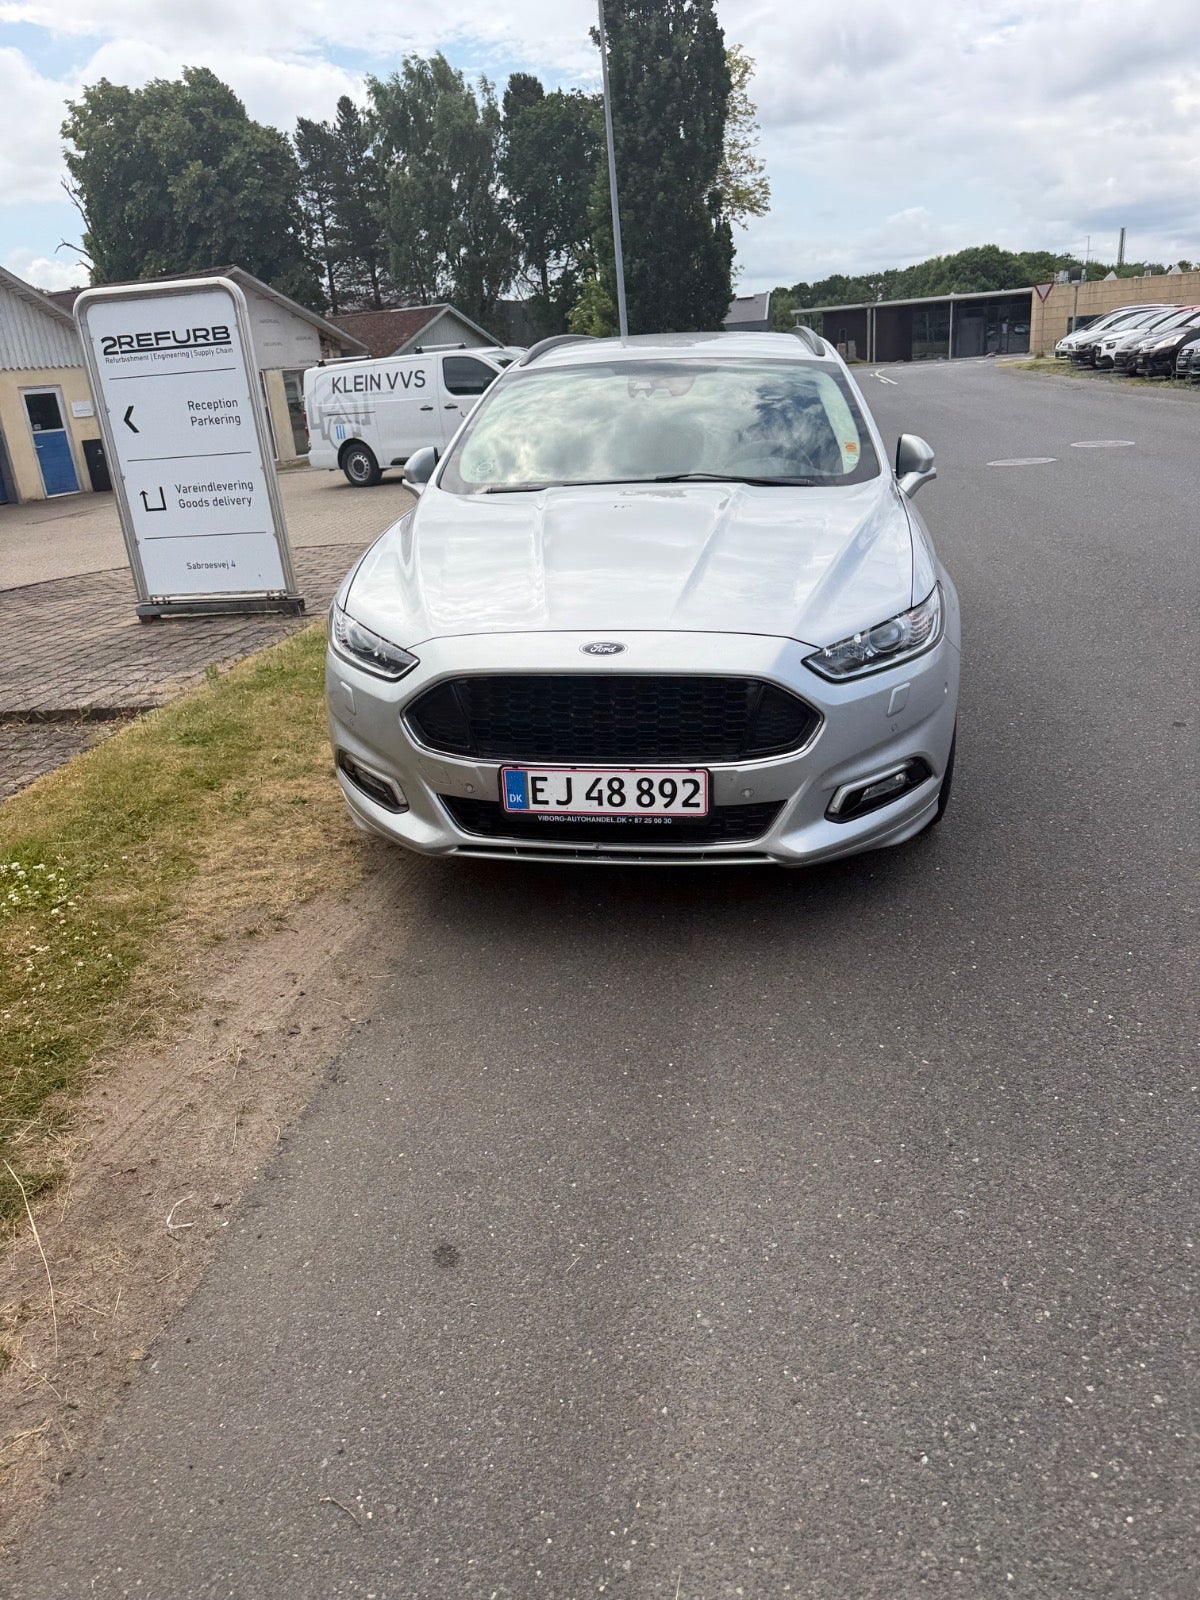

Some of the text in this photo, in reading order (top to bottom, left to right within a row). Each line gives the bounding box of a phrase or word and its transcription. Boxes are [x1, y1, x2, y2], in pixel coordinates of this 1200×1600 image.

[101, 325, 231, 356] 2REFURB
[105, 347, 233, 364] Refurbishment Engineering Supply Chain
[332, 369, 426, 394] KLEIN VVS
[187, 398, 239, 412] Reception
[190, 413, 241, 427] Parkering
[174, 480, 254, 494] Vareindlevering
[178, 496, 252, 508] Goods delivery
[186, 560, 236, 570] Sabroesvej 4
[590, 643, 617, 653] Ford
[509, 794, 523, 803] DK
[530, 776, 701, 808] EJ 48 892
